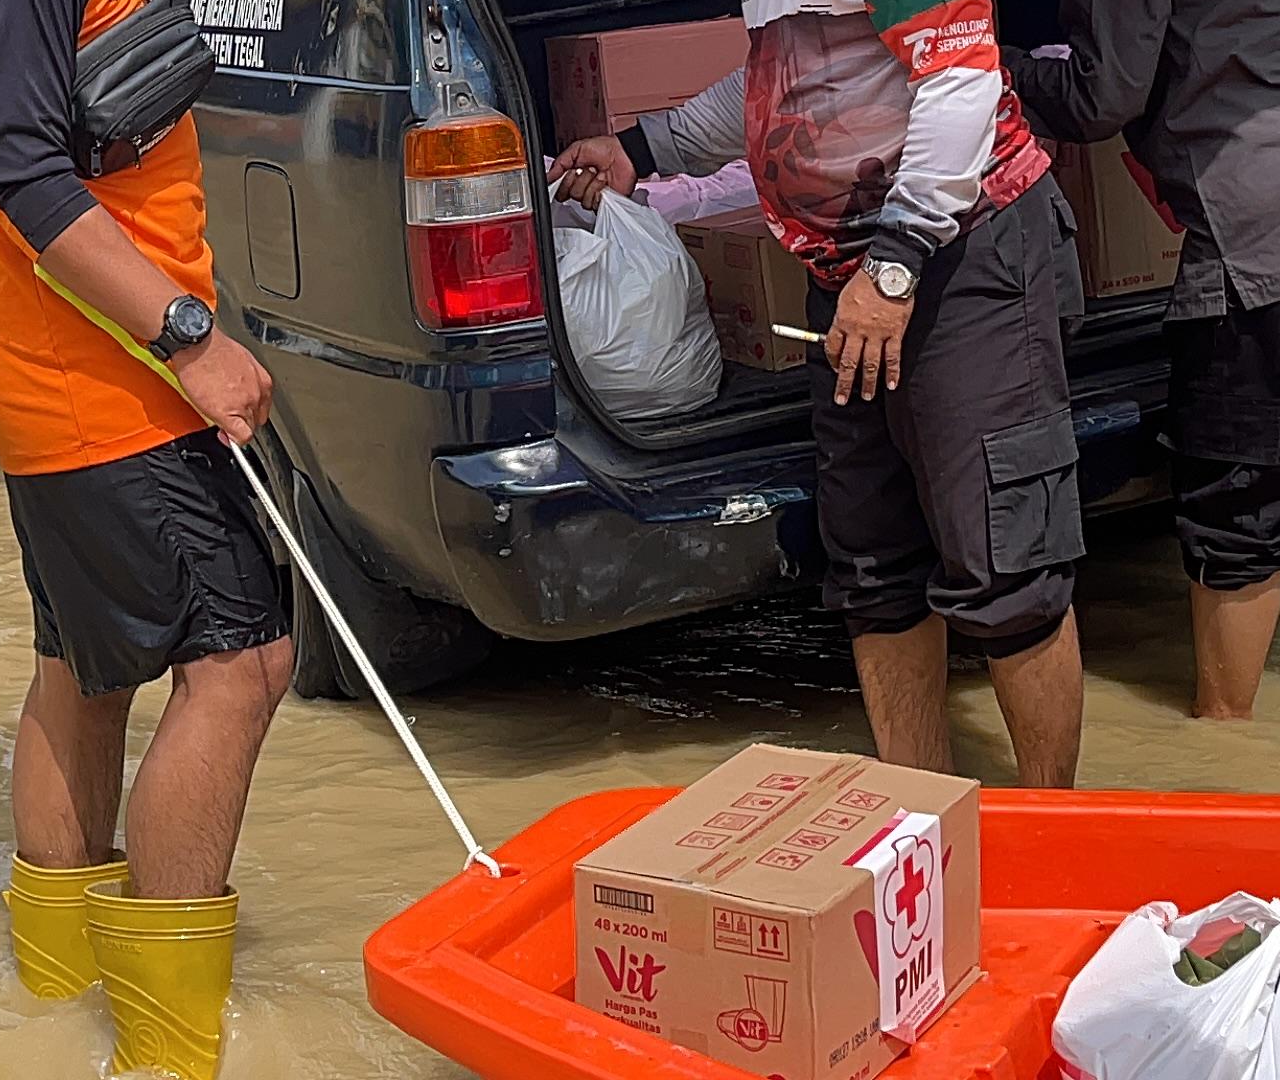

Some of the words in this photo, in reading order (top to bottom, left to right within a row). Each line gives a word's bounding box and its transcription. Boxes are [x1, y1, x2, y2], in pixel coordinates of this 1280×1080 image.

[233, 35, 265, 69] TEGAL
[594, 917, 611, 932] 48
[613, 922, 621, 933] x
[622, 924, 648, 940] 200
[651, 928, 668, 944] ml
[593, 945, 667, 1003] Vit
[895, 938, 933, 1016] PMI
[605, 999, 636, 1015] Harga
[639, 1006, 658, 1020] Pas
[738, 1020, 764, 1040] Vit
